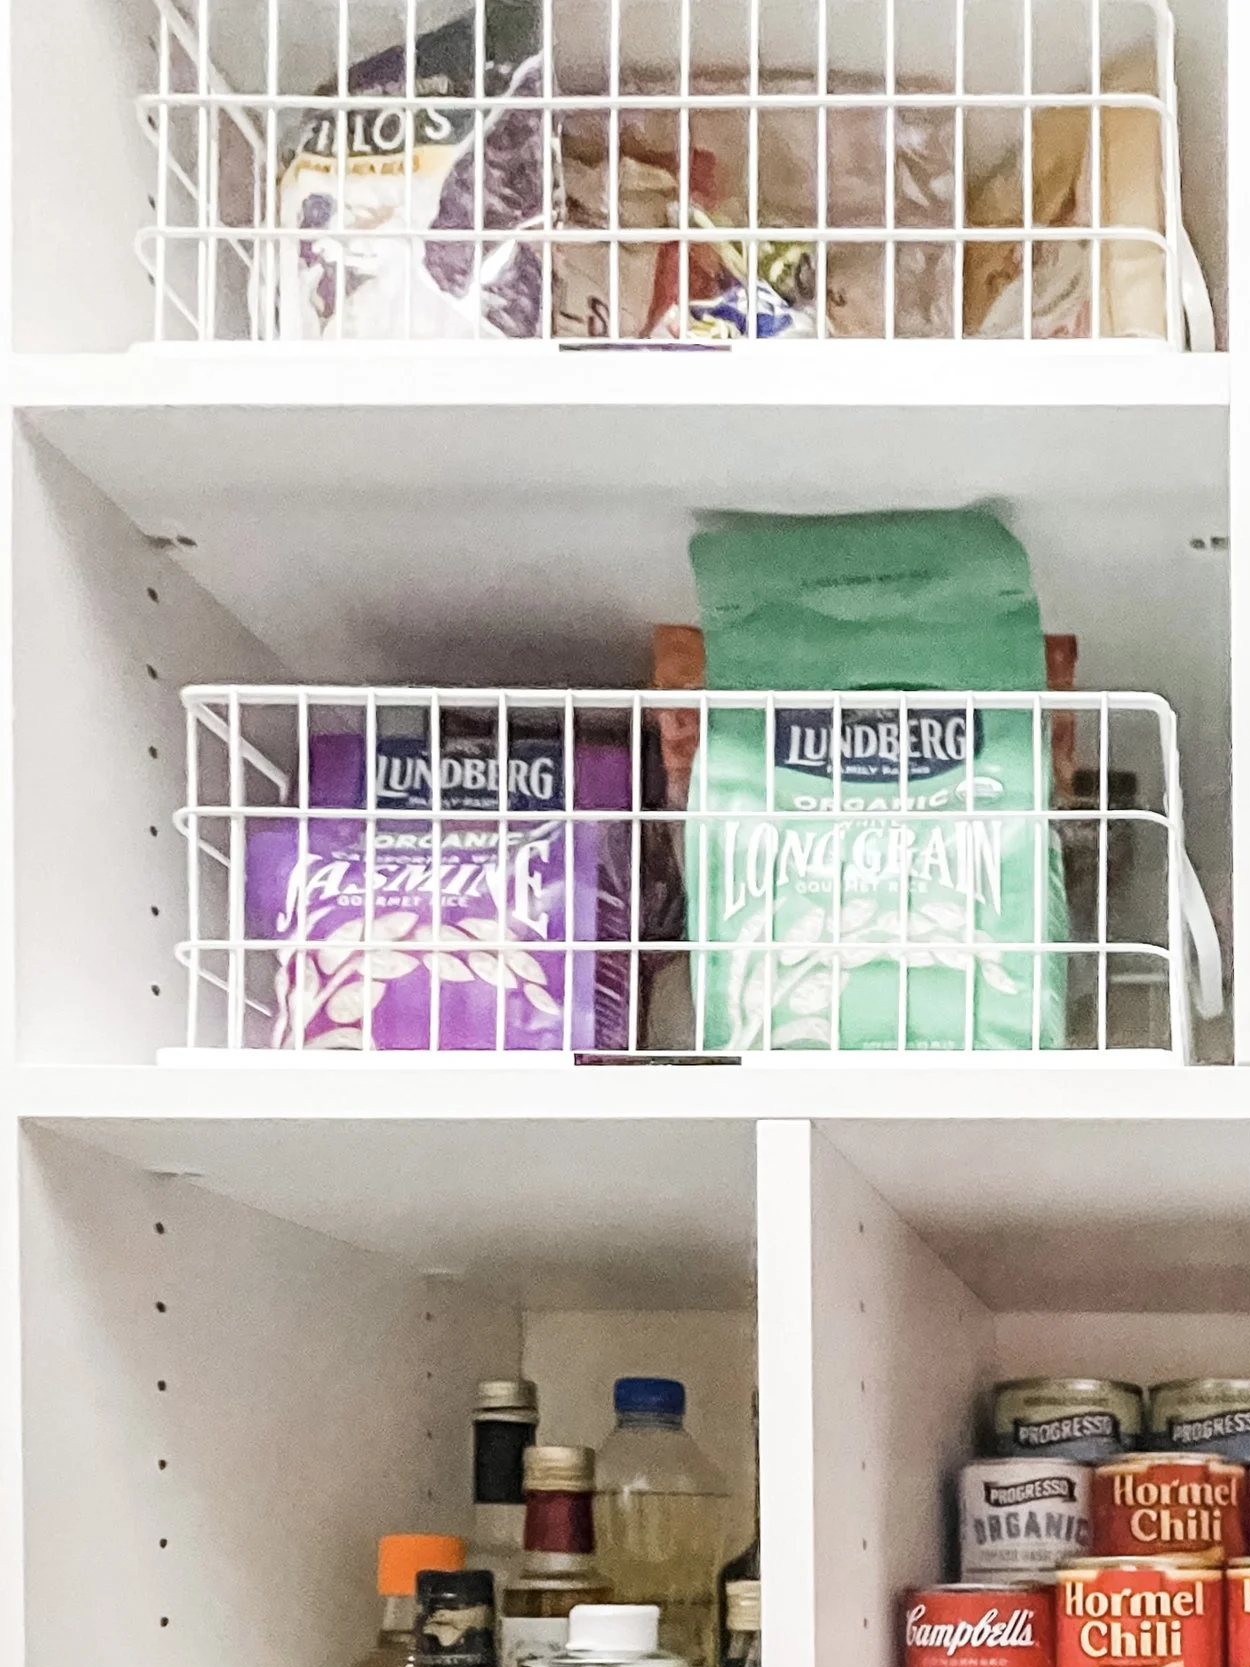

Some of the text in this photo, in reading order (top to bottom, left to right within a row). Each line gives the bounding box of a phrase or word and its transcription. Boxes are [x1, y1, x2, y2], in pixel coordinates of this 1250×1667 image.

[785, 717, 967, 767] LUNDBERG
[374, 754, 555, 800] LUNDBERG
[793, 788, 949, 811] ORGANIC
[723, 819, 1002, 921] LONG GRAIN
[277, 839, 550, 940] JASMINE
[1018, 1414, 1113, 1445] PROGRESSO
[989, 1478, 1070, 1504] PROGRESSO
[1113, 1474, 1237, 1507] Hormel
[973, 1510, 1091, 1547] ORGANIC
[1130, 1507, 1223, 1542] Chili
[1065, 1580, 1204, 1617] Hormel
[906, 1603, 1037, 1655] Campbell's
[1080, 1620, 1183, 1658] Chili
